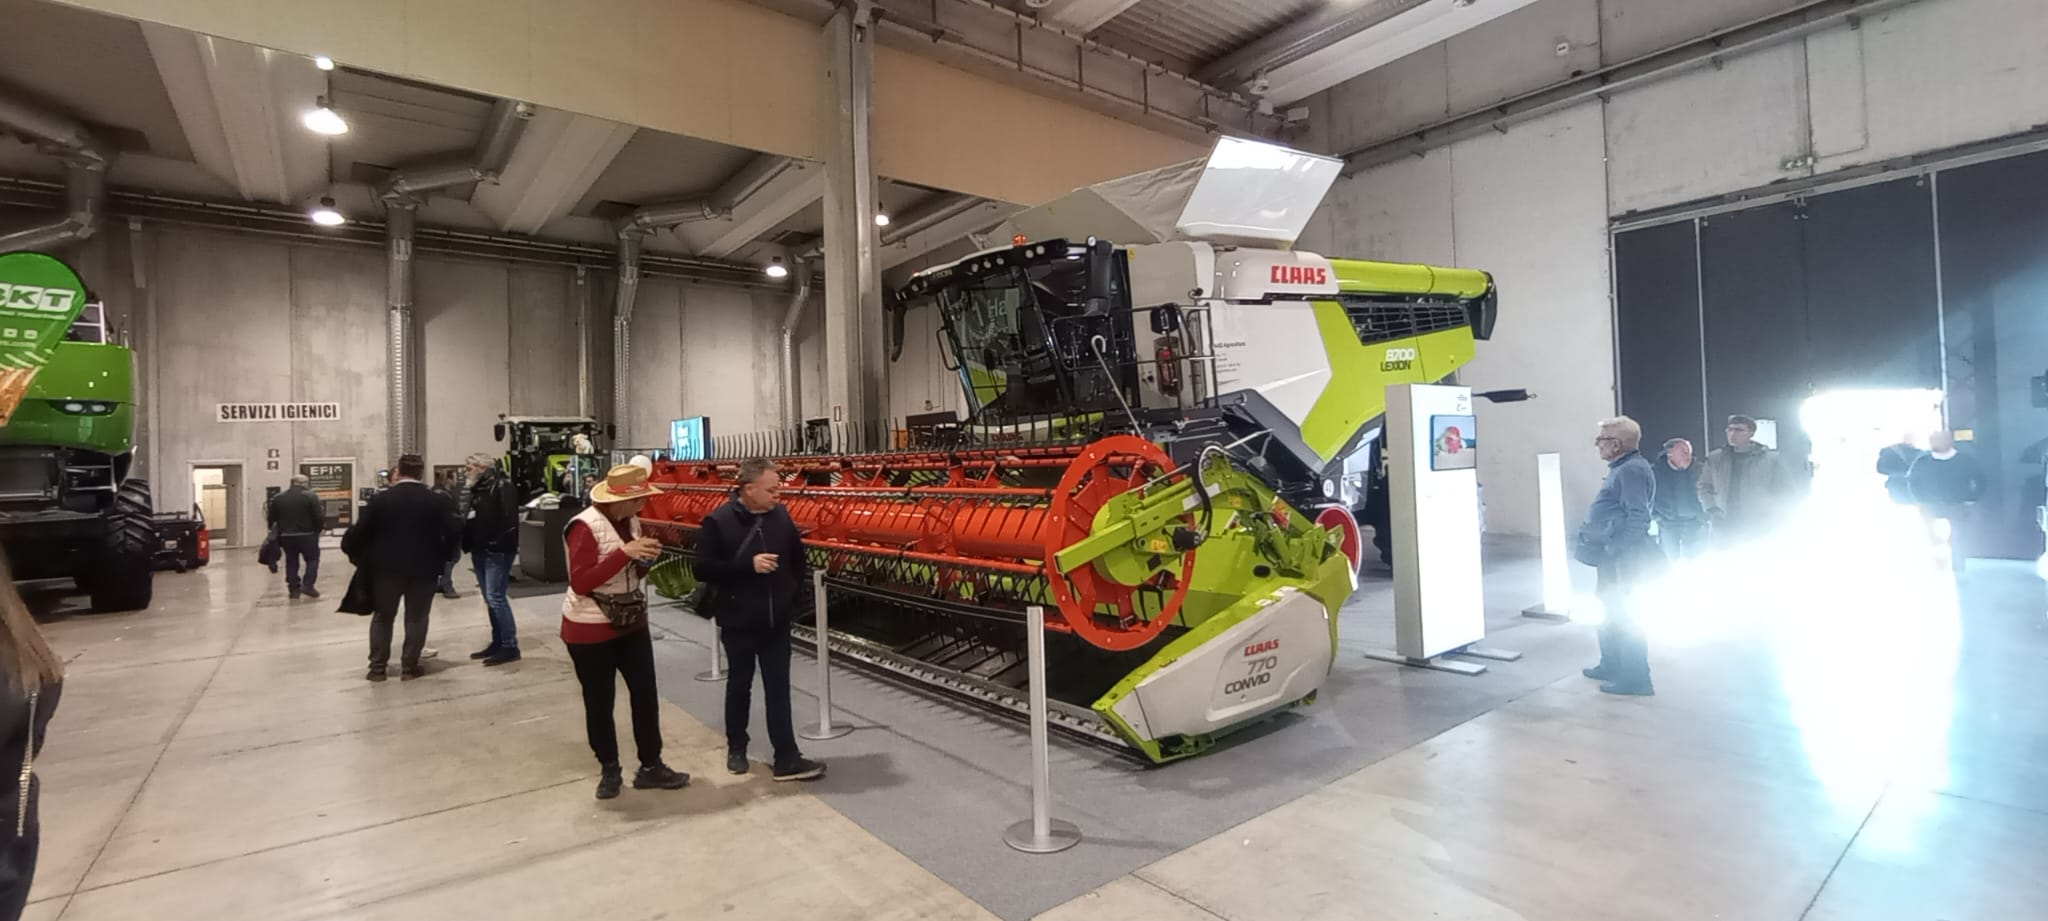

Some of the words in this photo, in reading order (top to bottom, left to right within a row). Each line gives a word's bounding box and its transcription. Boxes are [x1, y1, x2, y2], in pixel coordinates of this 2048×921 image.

[1271, 266, 1326, 284] CLAAS
[0, 284, 75, 311] KT
[1385, 348, 1415, 361] 8700
[1380, 360, 1411, 372] LEXION
[221, 405, 276, 419] SERVIZI
[281, 404, 337, 418] IGIENICI
[1244, 639, 1280, 656] CLAAS
[1247, 656, 1278, 675] 770
[1224, 673, 1271, 695] CONVIO
